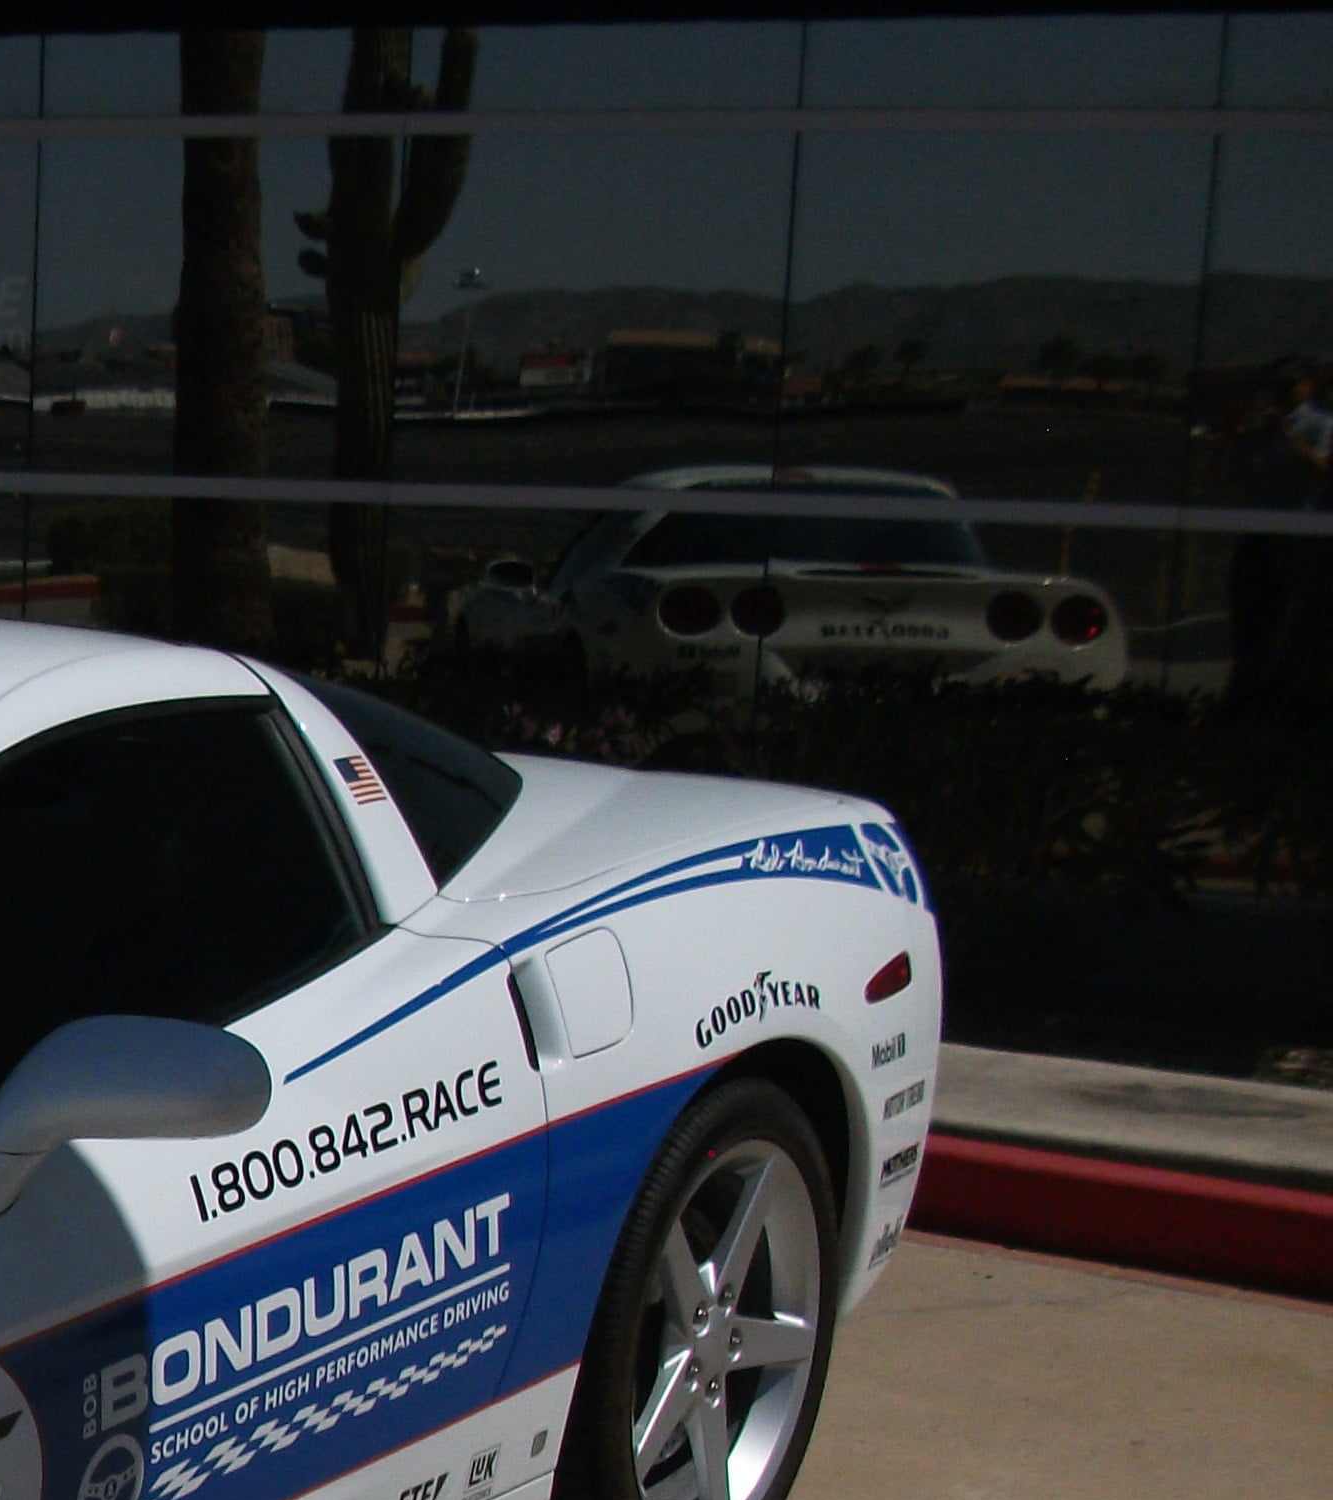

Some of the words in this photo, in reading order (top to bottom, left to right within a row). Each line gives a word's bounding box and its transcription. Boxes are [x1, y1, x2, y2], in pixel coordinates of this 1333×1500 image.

[696, 972, 821, 1049] GOODYEAR
[190, 1060, 504, 1222] 1.800.842.RACE
[82, 1372, 98, 1441] BOB
[150, 1412, 229, 1465] SCHOOL
[235, 1399, 259, 1425] OF
[264, 1371, 310, 1412] HIGH
[315, 1316, 439, 1384] PERFORMANCE
[443, 1281, 511, 1331] DRIVING
